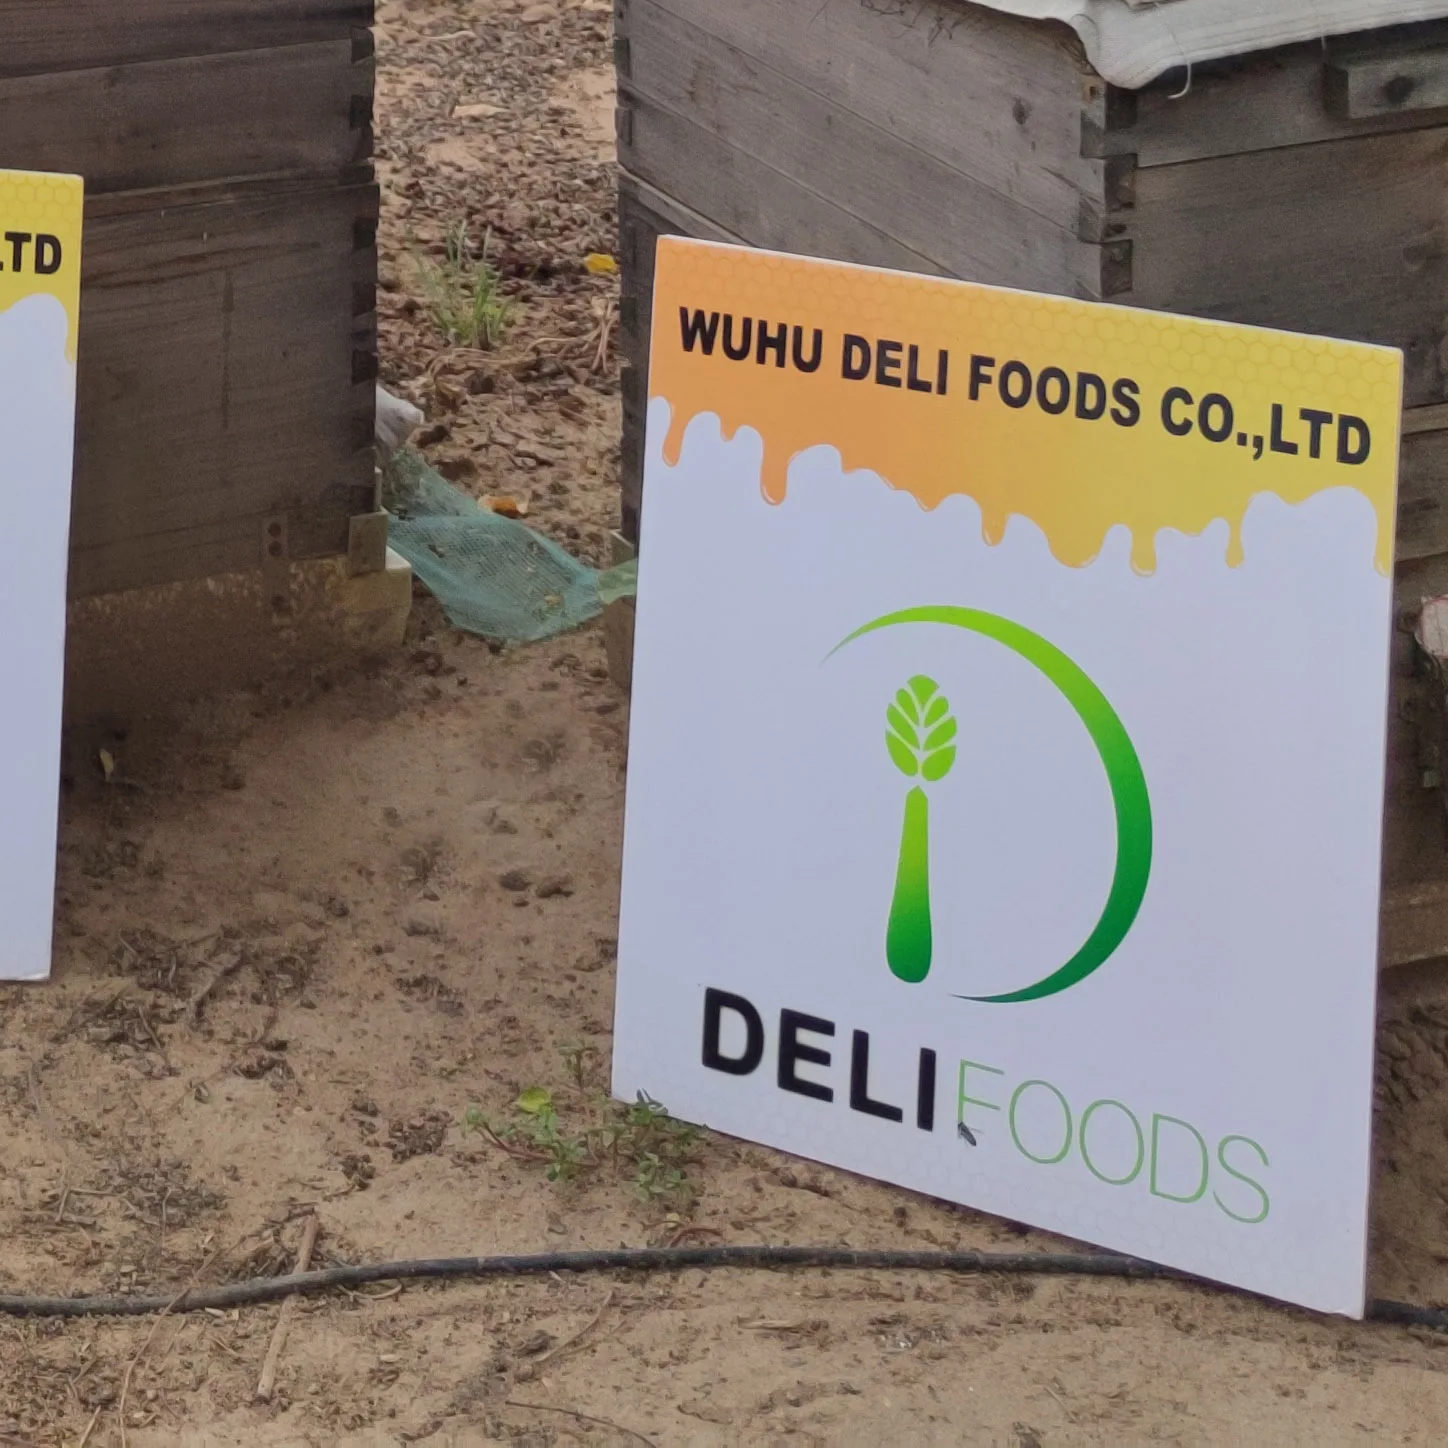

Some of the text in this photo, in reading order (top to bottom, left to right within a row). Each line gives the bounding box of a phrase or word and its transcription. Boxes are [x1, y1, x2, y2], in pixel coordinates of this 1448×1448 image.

[678, 306, 1373, 466] WUHU DELI FOODS CO.,LTD
